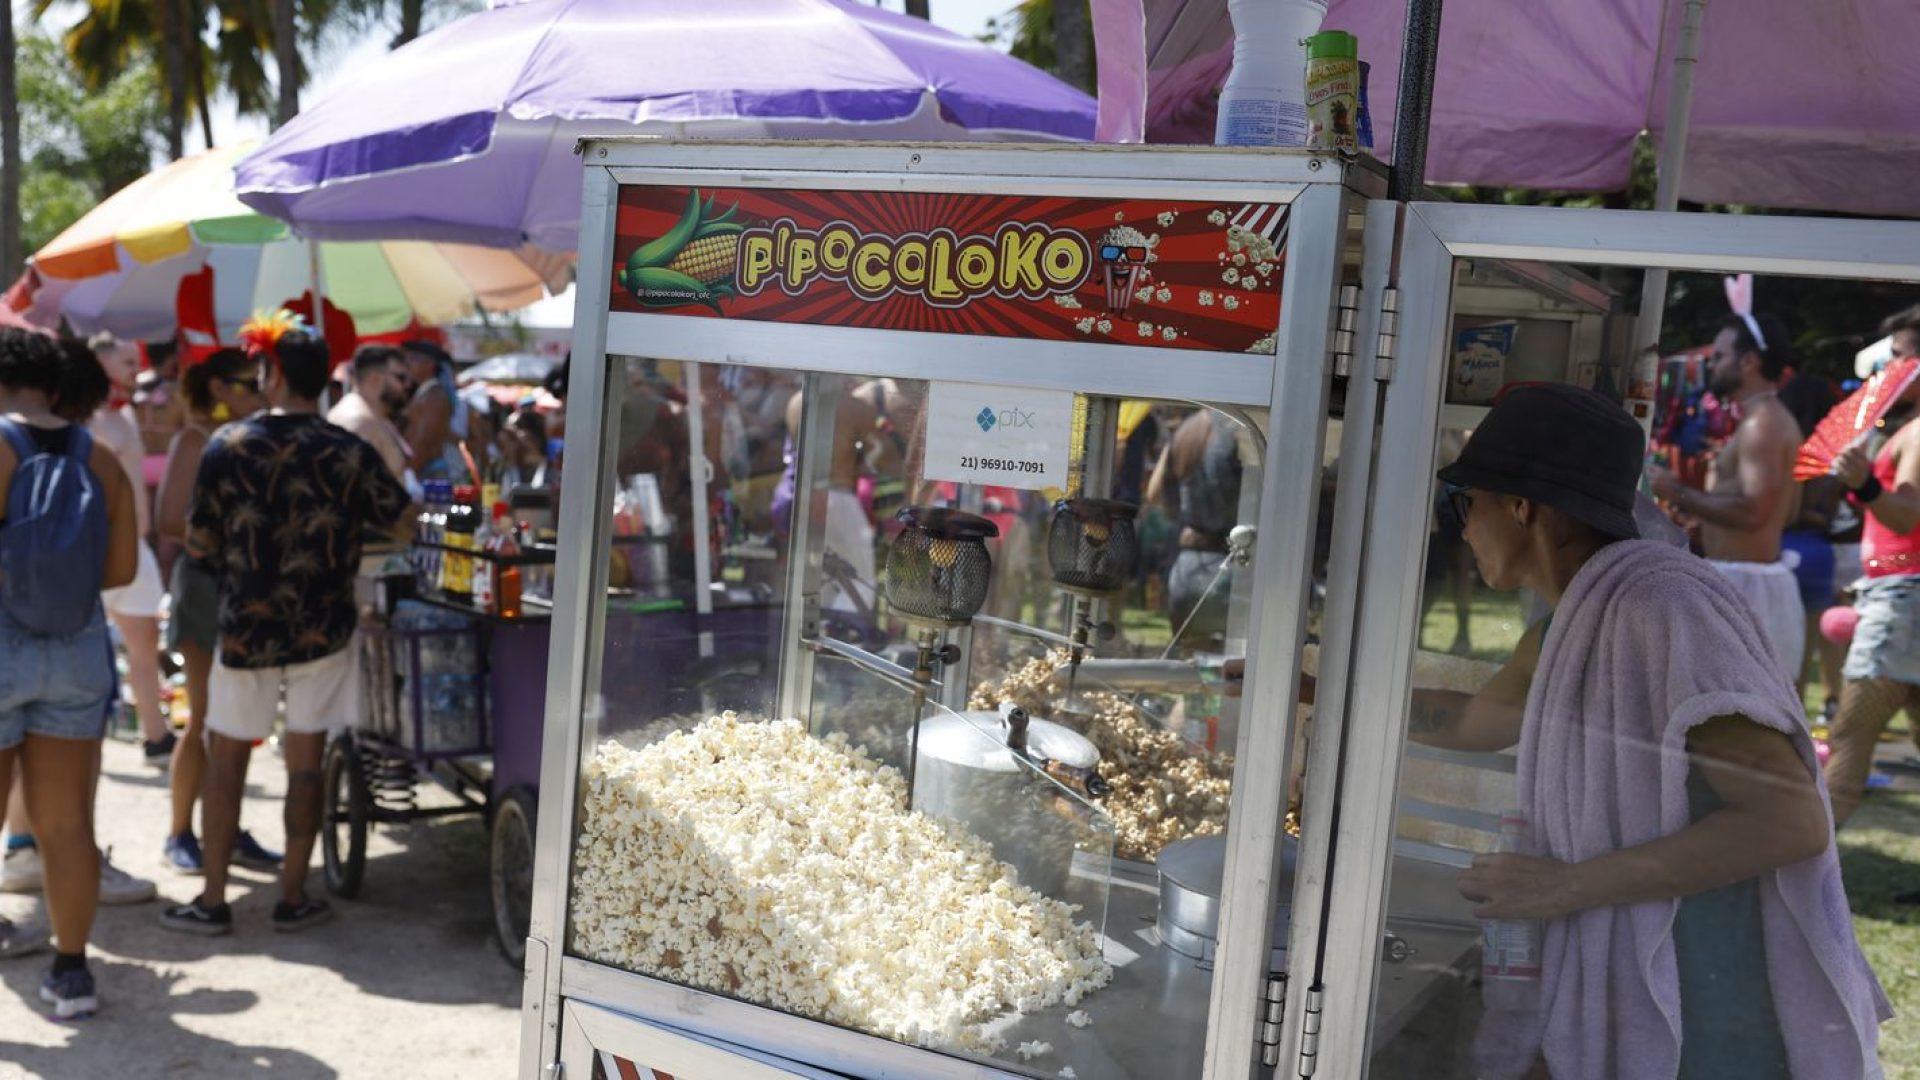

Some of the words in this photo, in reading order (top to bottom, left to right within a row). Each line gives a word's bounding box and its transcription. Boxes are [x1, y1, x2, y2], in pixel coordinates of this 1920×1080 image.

[740, 225, 1087, 300] PIPOCOLOKO
[998, 407, 1036, 431] pix
[960, 456, 979, 471] 21)
[981, 459, 1045, 474] 96910-7091
